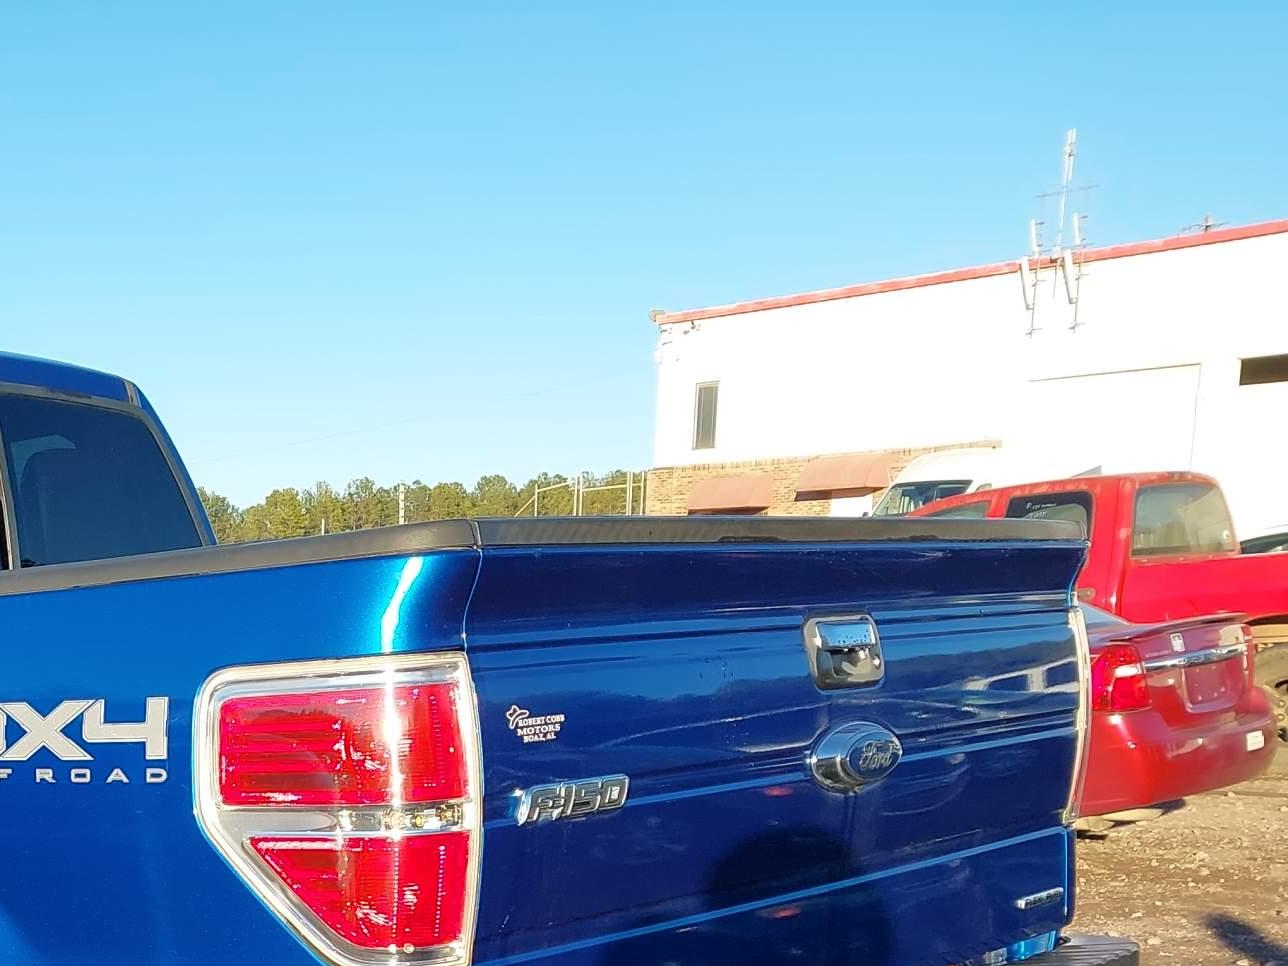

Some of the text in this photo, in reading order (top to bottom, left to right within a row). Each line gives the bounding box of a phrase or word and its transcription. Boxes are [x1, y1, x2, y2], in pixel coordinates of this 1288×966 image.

[518, 717, 545, 727] ROBERT
[517, 723, 561, 736] MOTORS
[546, 731, 557, 740] AL
[859, 740, 901, 770] Ford
[35, 768, 169, 783] ROAD
